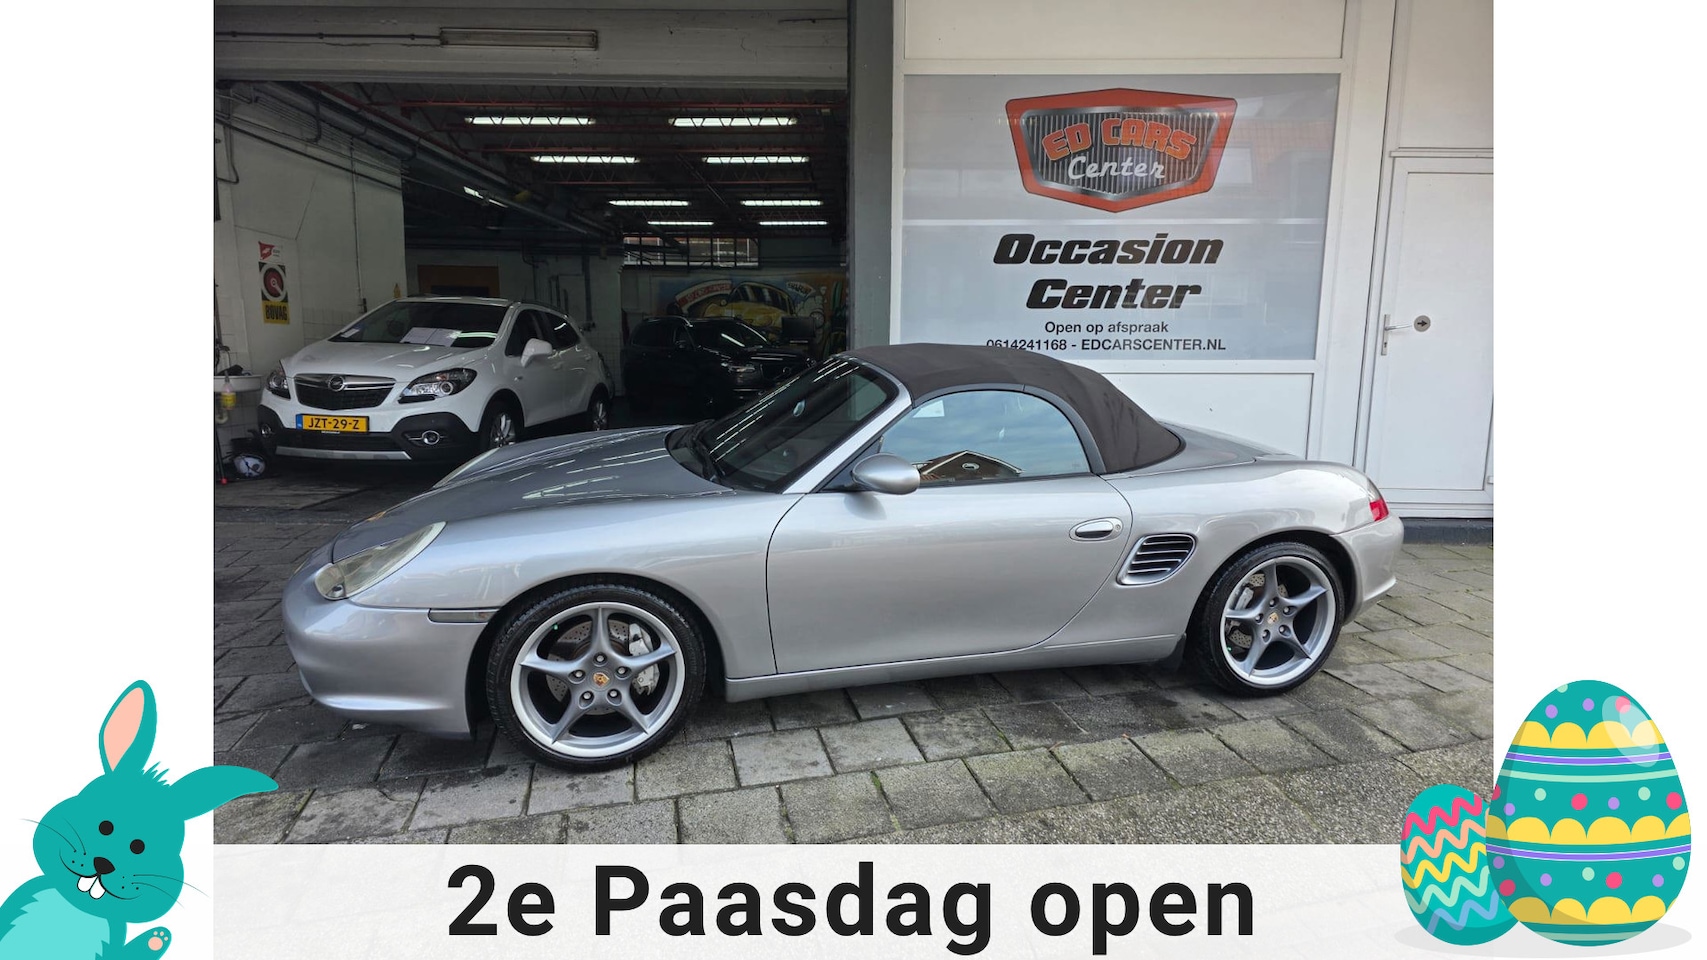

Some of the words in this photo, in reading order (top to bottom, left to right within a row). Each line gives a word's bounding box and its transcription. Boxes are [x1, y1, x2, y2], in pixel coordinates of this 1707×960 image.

[1042, 123, 1092, 161] ED
[1101, 118, 1197, 160] CARS
[1068, 156, 1166, 180] Center
[993, 233, 1224, 264] Occasion
[1026, 278, 1202, 309] Center
[265, 304, 288, 321] BOVAG
[1045, 321, 1082, 335] Open
[1086, 324, 1104, 335] op
[1108, 321, 1169, 335] afspraak
[1081, 339, 1226, 351] EDCARSCENTER.NL
[308, 418, 360, 430] JZT-29-Z
